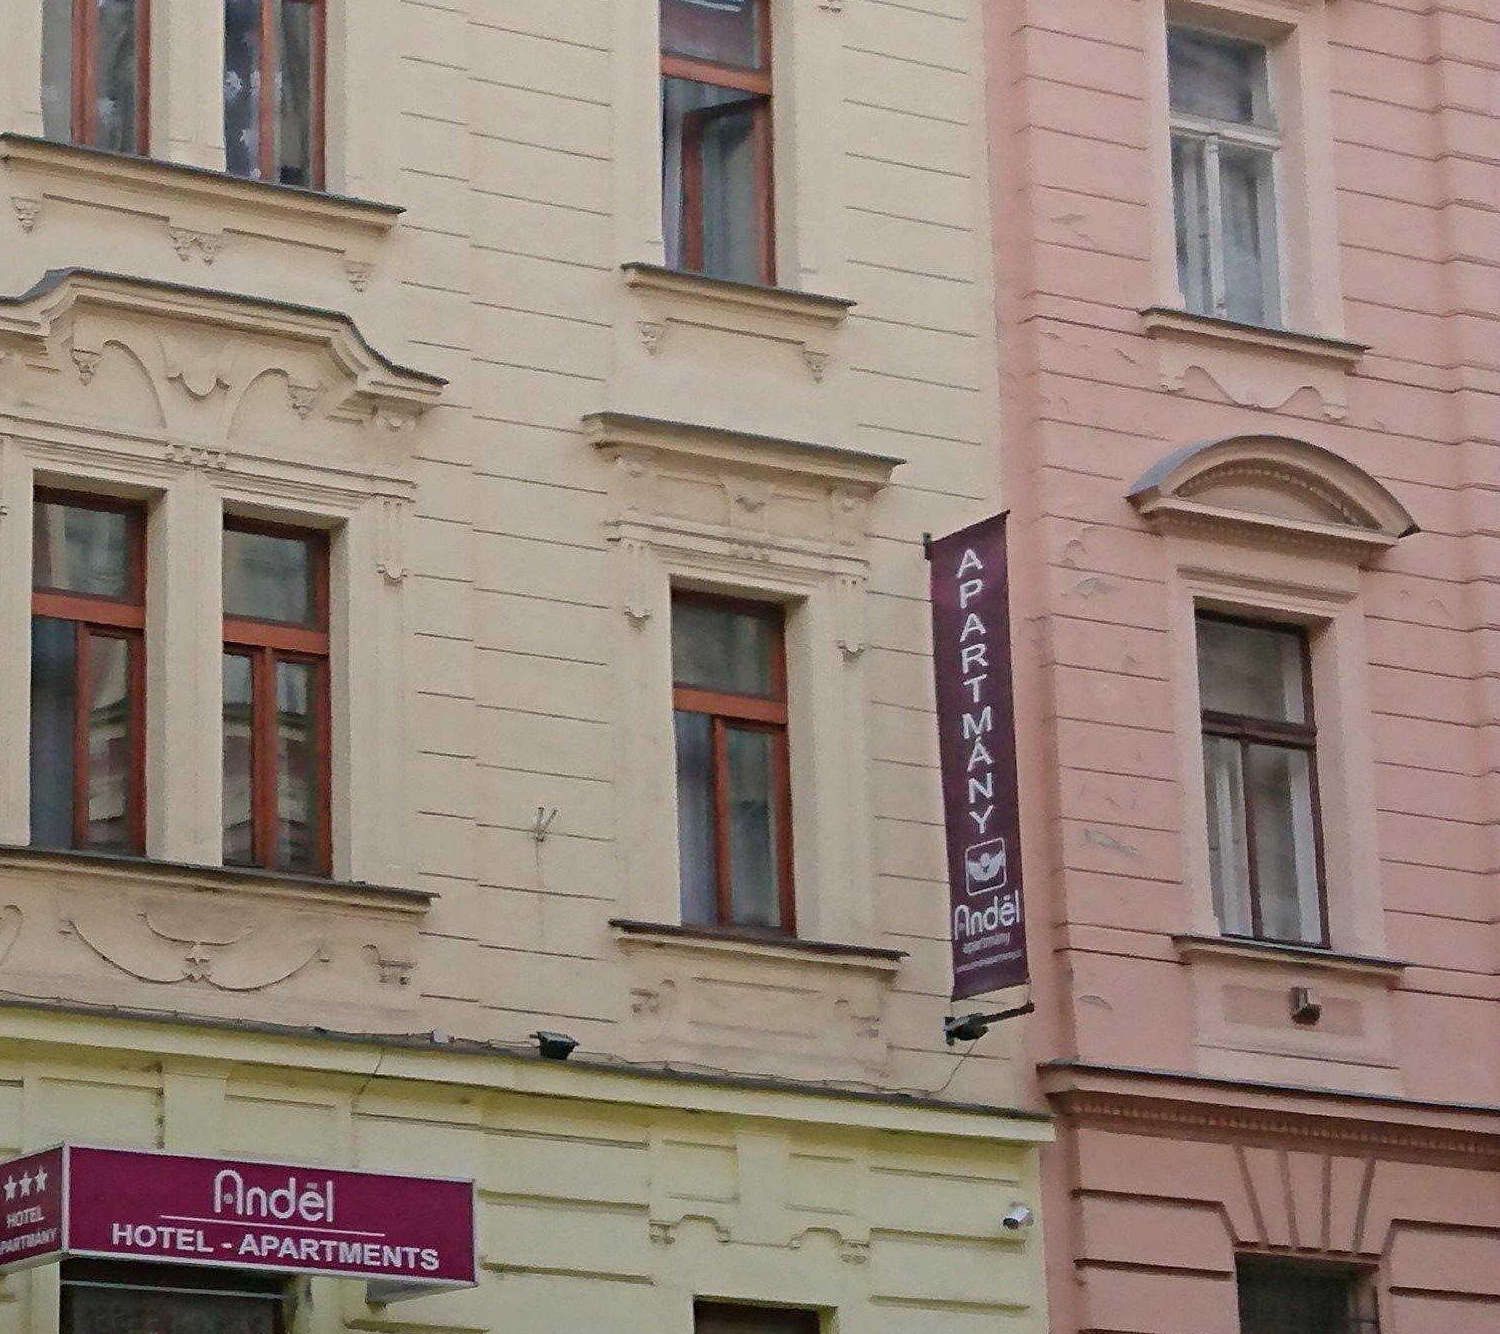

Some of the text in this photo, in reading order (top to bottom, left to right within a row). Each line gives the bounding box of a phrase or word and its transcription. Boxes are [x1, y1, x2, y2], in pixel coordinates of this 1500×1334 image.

[956, 546, 994, 835] APARTMÁNY
[6, 1205, 45, 1229] HOTEL
[112, 1222, 213, 1253] HOTEL
[238, 1233, 440, 1272] APARTMENTS
